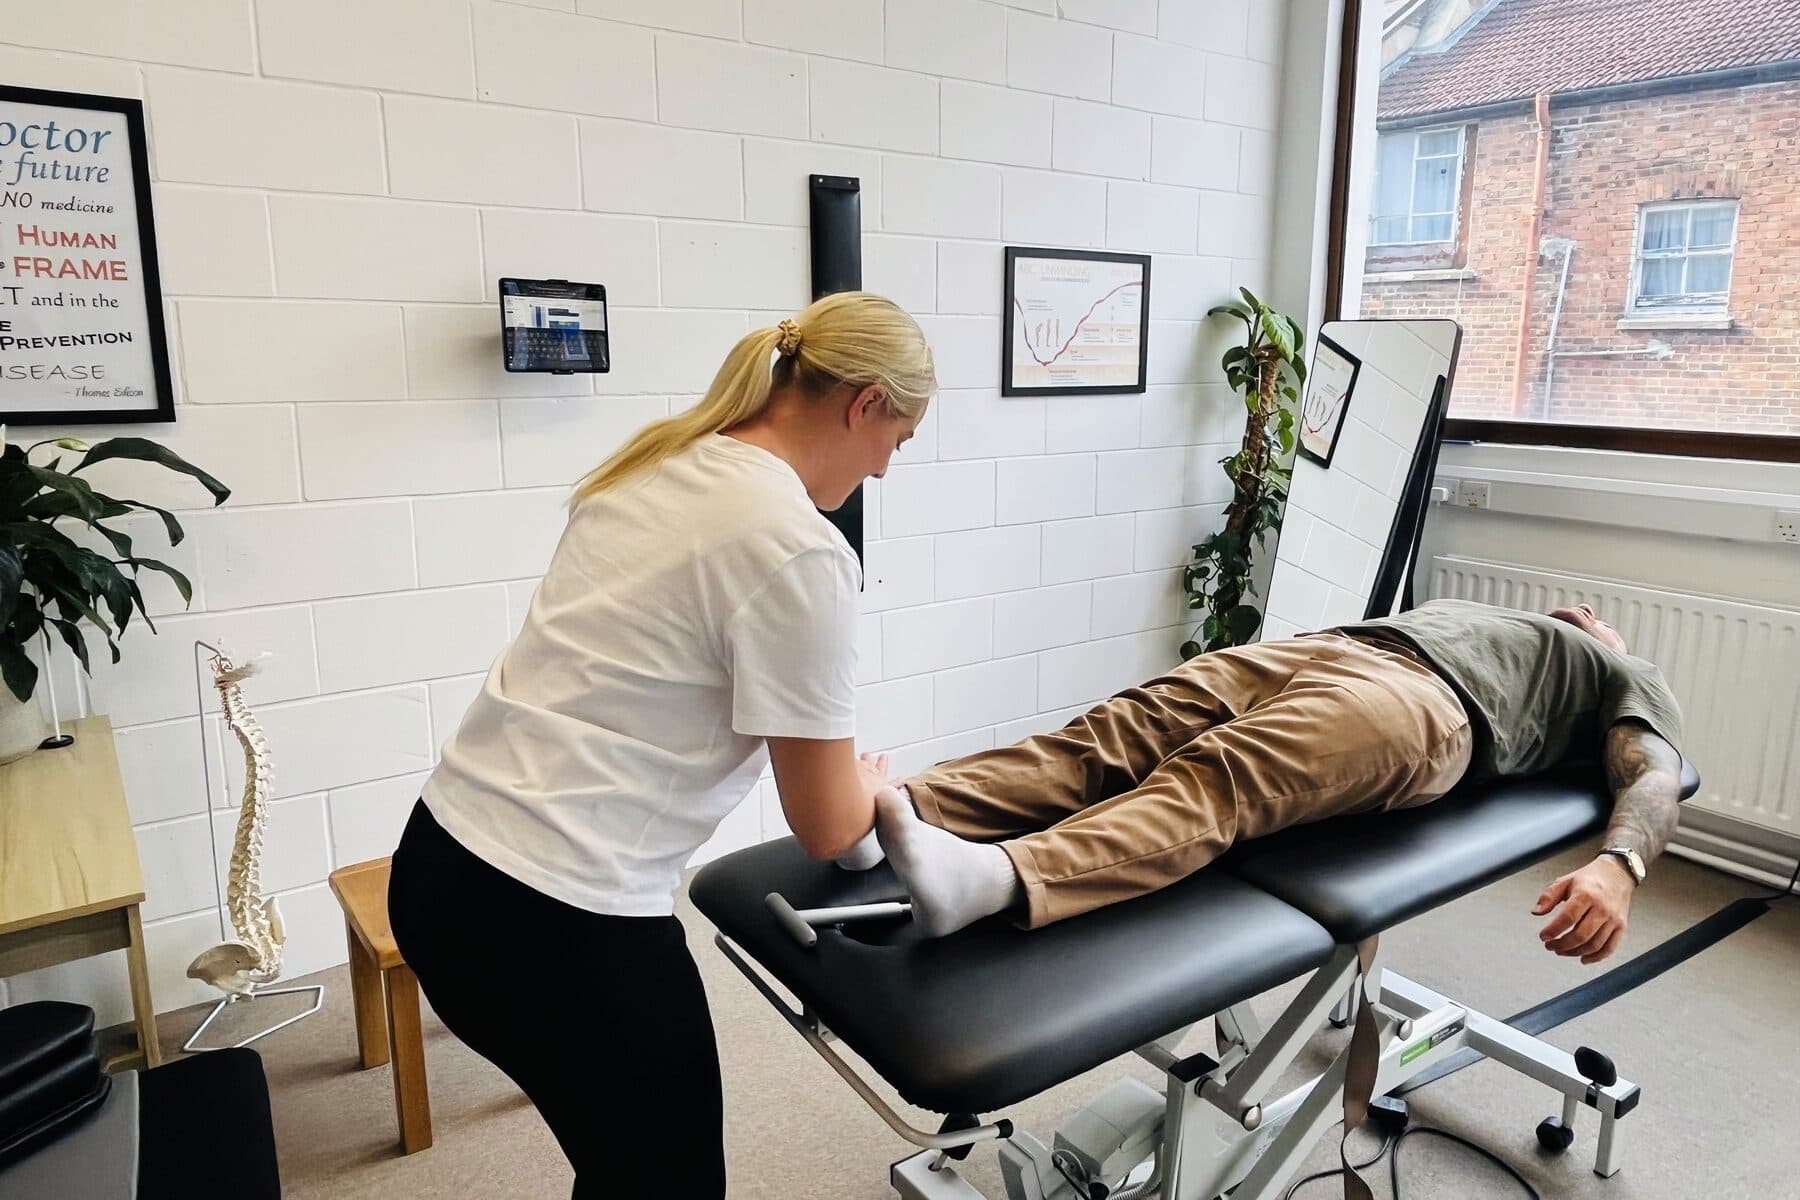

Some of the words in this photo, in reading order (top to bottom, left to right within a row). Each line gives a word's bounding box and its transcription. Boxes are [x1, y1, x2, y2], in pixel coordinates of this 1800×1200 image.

[6, 151, 109, 185] future
[0, 191, 33, 208] NO
[41, 196, 114, 214] medicine
[17, 223, 117, 250] HUMAN
[13, 256, 128, 281] FRAME
[0, 286, 24, 305] T
[31, 292, 64, 307] and
[70, 293, 86, 307] in
[92, 293, 119, 308] the
[0, 332, 132, 350] PREVENTION
